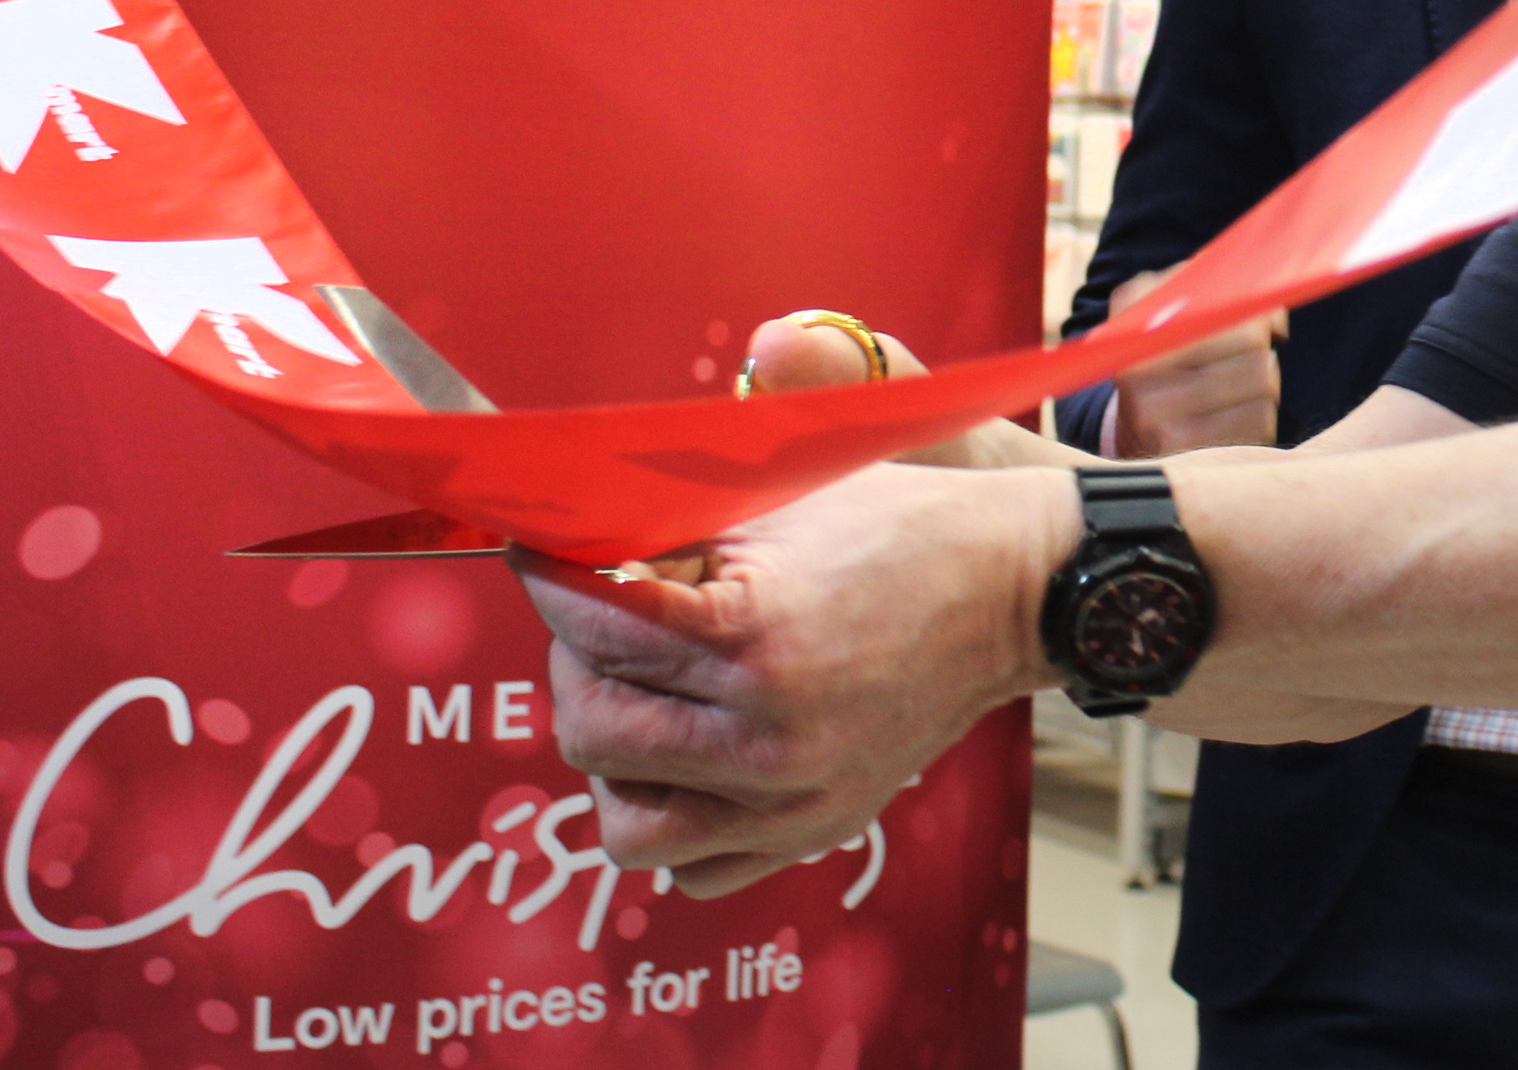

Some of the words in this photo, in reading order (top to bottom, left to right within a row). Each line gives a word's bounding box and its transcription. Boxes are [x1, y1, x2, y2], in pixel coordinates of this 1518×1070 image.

[253, 995, 395, 1052] Low
[416, 978, 607, 1054] prices
[627, 961, 710, 1016] for
[725, 942, 804, 1002] life
